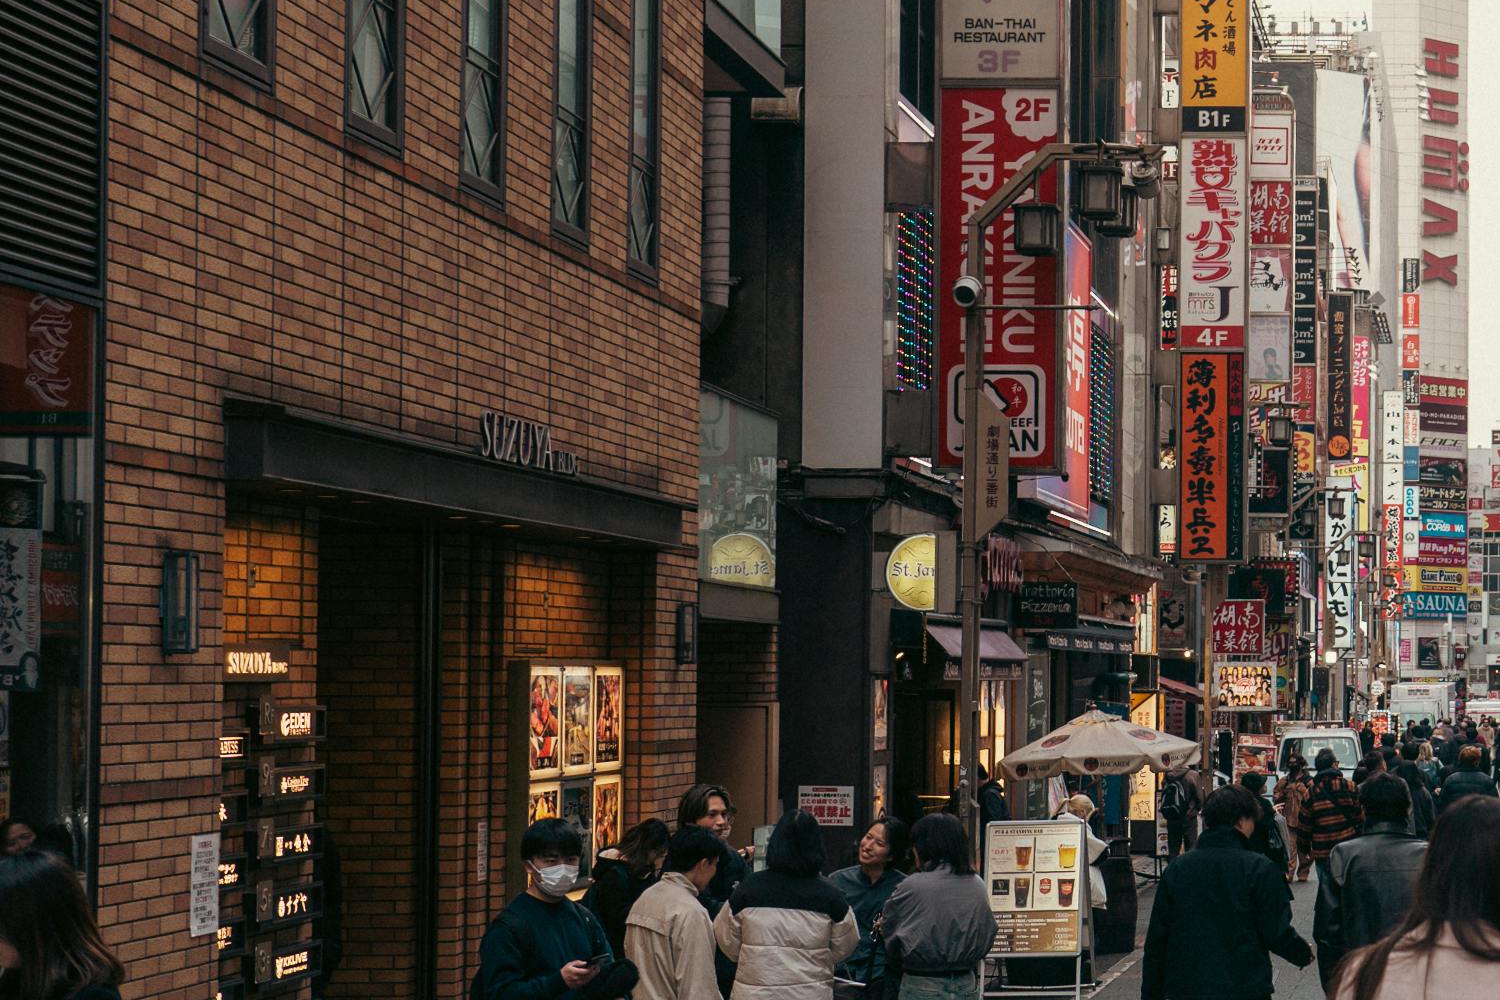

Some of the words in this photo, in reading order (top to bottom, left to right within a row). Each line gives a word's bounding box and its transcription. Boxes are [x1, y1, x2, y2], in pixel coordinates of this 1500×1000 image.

[953, 31, 1046, 43] RESTAURANT
[977, 49, 1021, 73] 3F
[1014, 98, 1051, 121] 2F
[1198, 109, 1231, 128] B1F
[1197, 328, 1229, 346] 4F
[1420, 383, 1466, 398] 全店営業中
[1011, 417, 1034, 427] EEF
[480, 410, 554, 472] SUZUYA
[986, 424, 999, 509] 劇場通り一番街
[892, 560, 911, 577] St.
[1417, 595, 1467, 612] SAUNA
[1213, 603, 1261, 628] 湖南
[290, 712, 311, 729] EDEN
